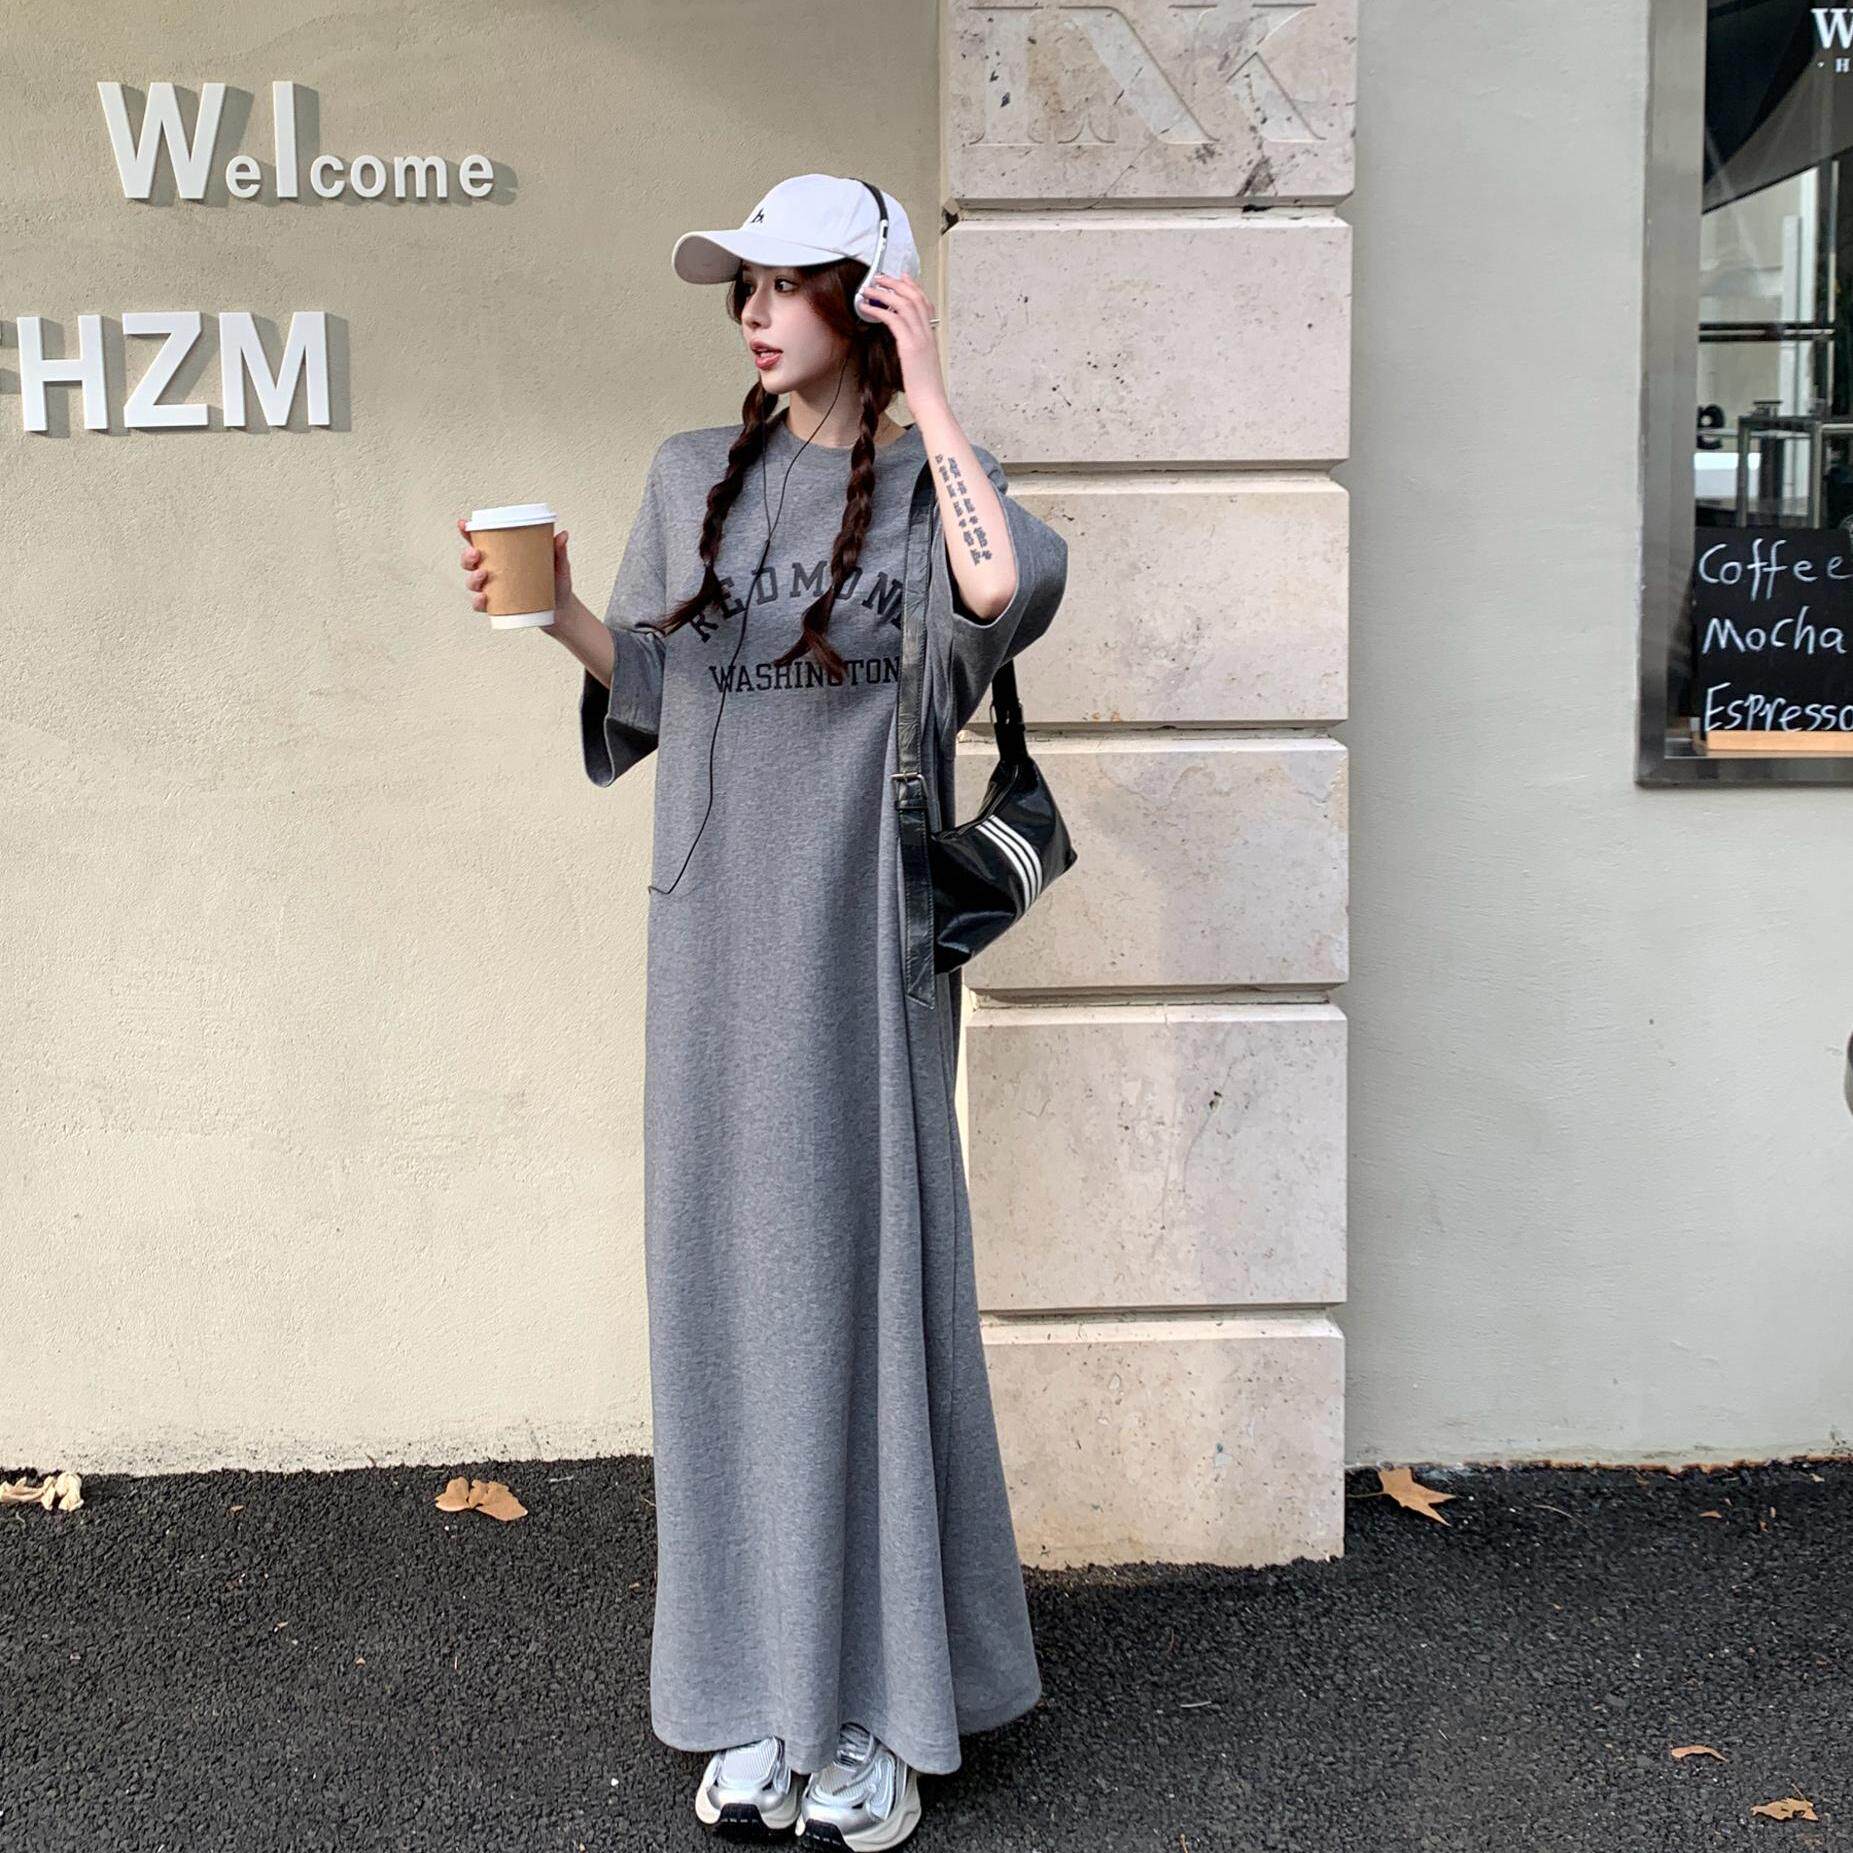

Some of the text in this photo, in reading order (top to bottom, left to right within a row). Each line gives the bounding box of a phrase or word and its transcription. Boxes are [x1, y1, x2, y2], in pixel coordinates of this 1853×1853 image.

[97, 80, 495, 200] Welcome
[1699, 537, 1853, 600] Coffee
[1702, 605, 1847, 655] Mocha
[1704, 682, 1853, 733] Espresso
